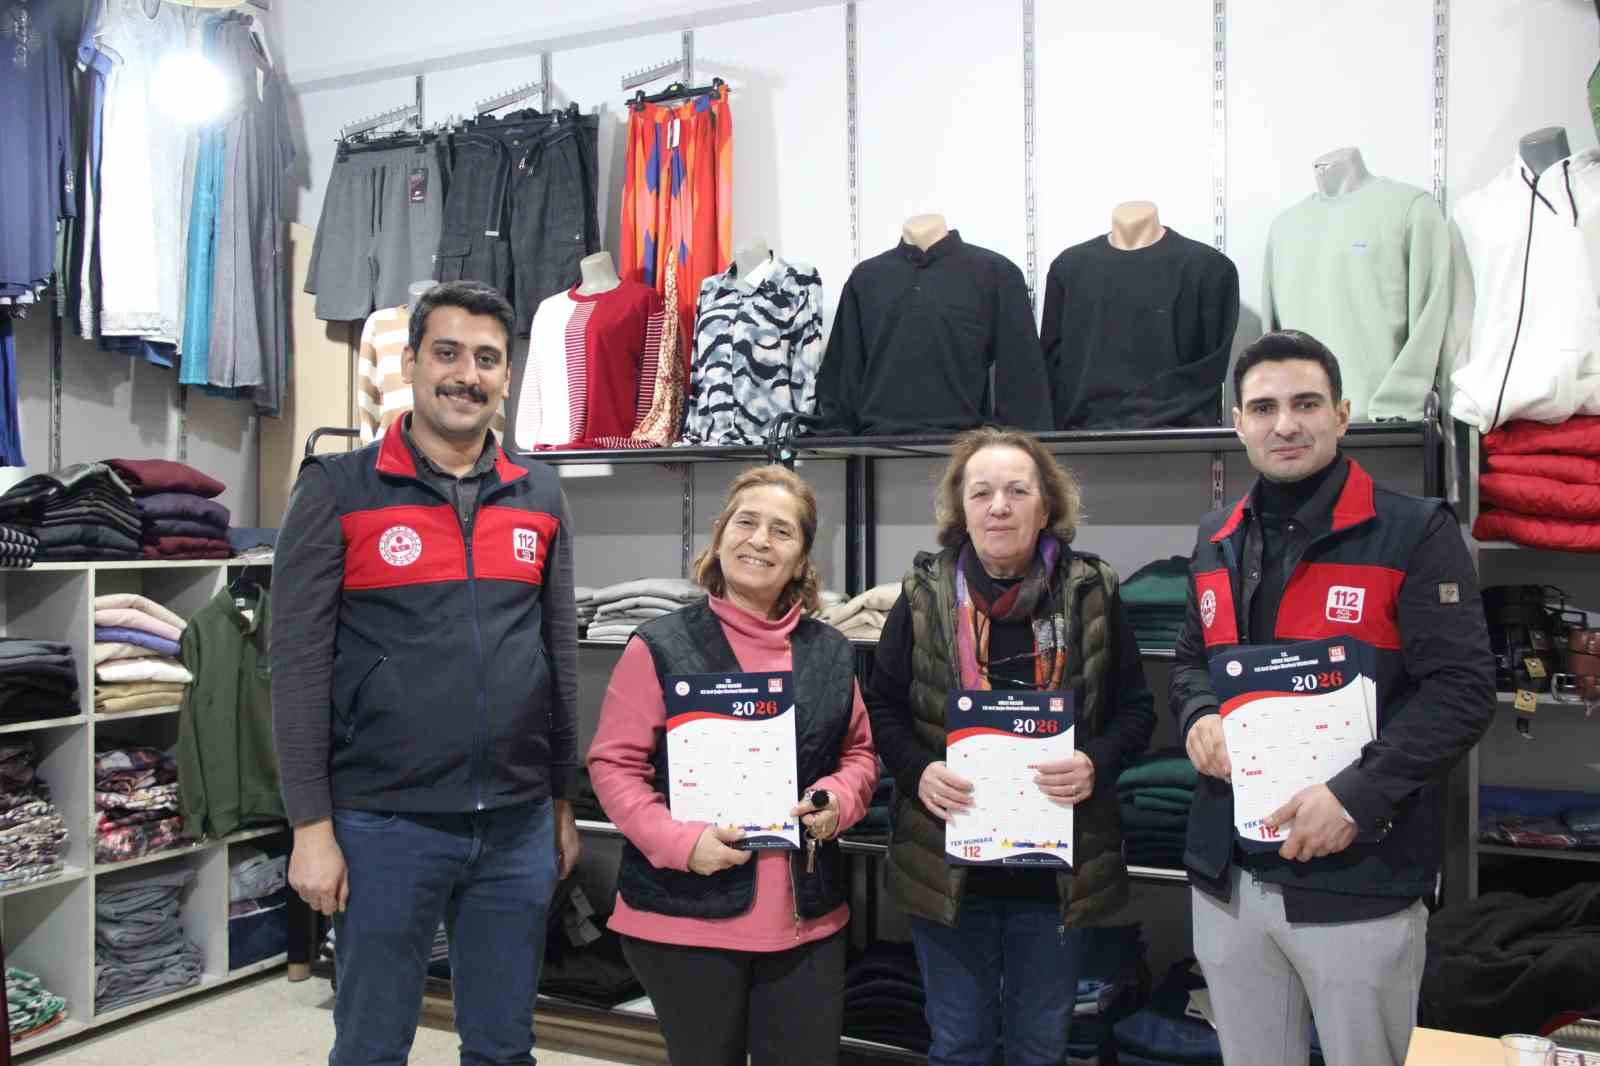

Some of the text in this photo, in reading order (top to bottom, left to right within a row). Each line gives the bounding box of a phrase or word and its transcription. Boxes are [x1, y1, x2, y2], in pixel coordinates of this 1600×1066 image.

[518, 532, 534, 549] 112
[1334, 590, 1359, 607] 112
[1292, 671, 1343, 691] 2026
[732, 700, 777, 716] 2026
[1013, 718, 1057, 733] 2026
[1259, 825, 1280, 839] 112
[963, 845, 981, 858] 112
